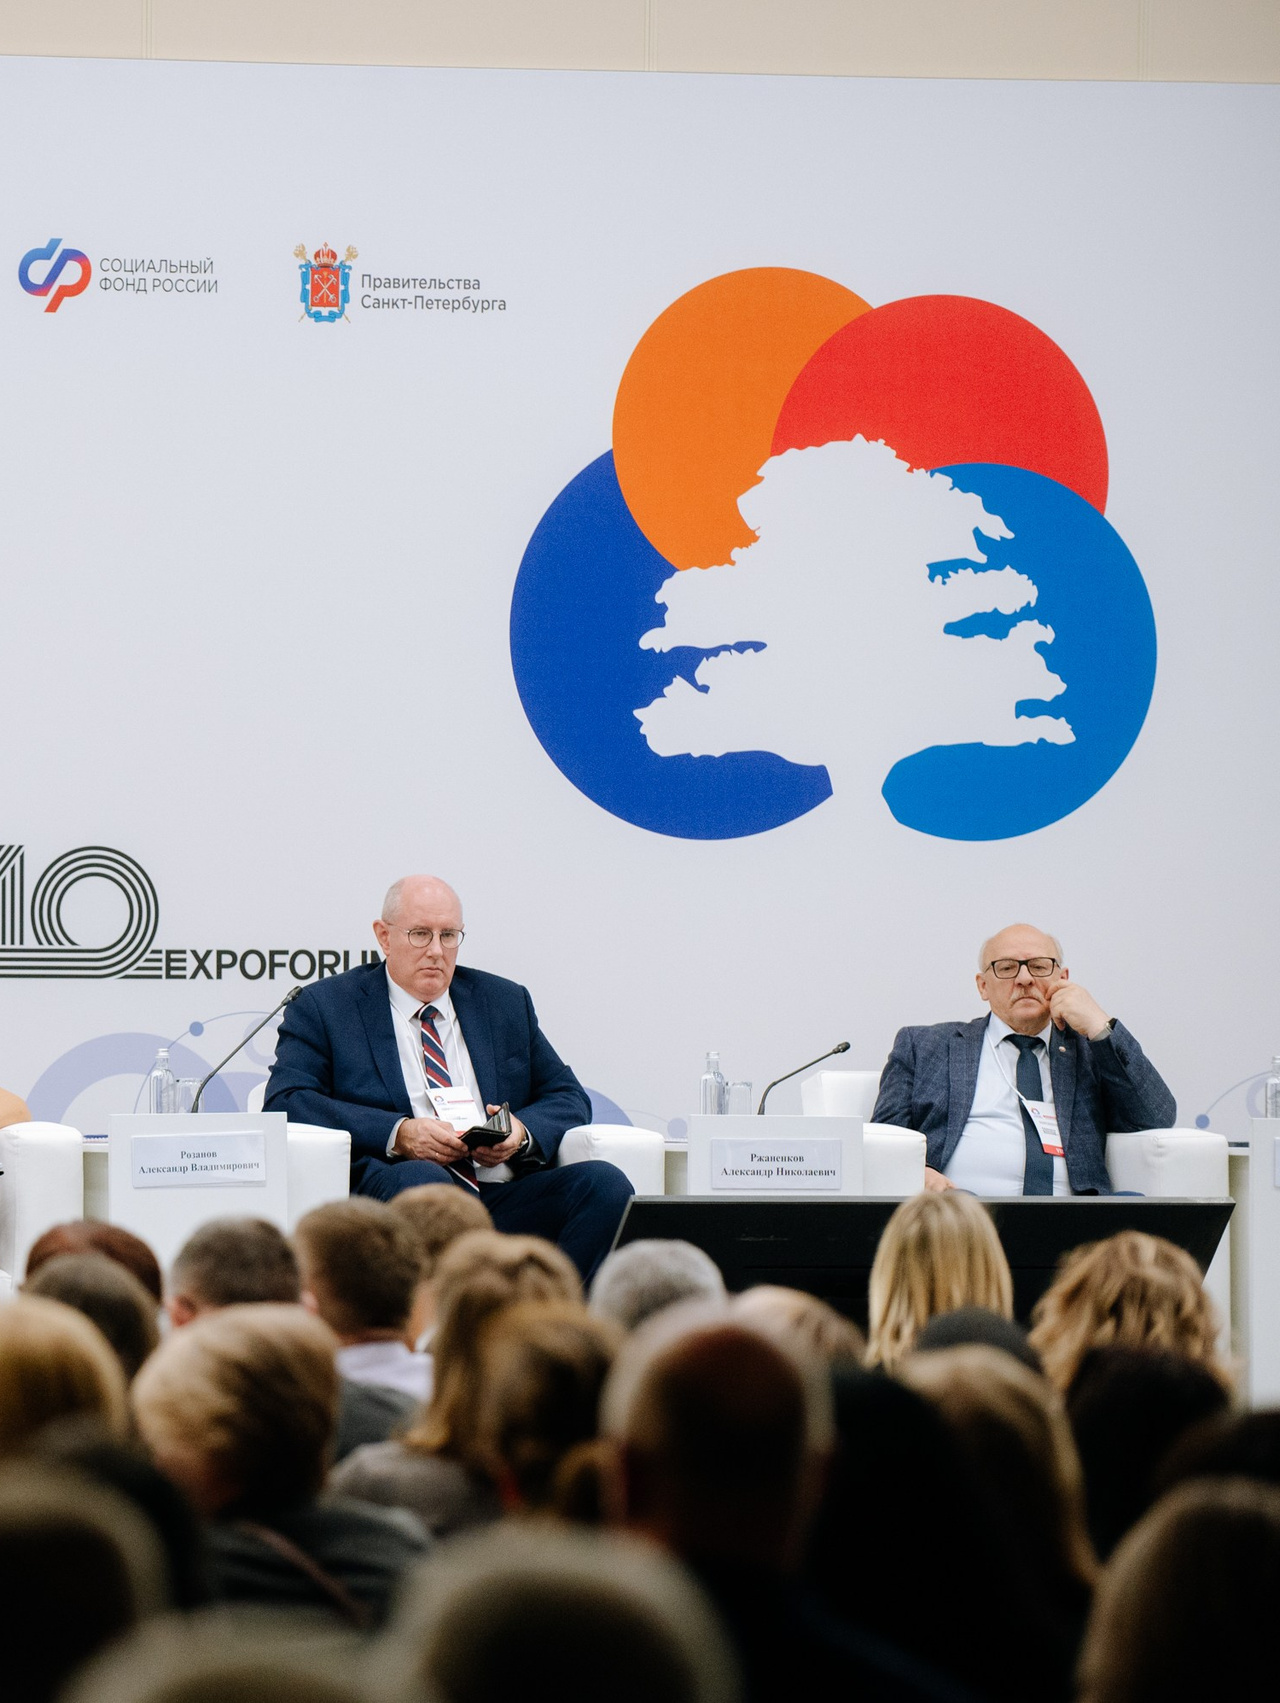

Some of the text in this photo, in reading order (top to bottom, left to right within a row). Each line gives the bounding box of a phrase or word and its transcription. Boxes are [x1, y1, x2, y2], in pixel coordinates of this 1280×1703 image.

[99, 257, 214, 275] СОЦИАЛЬНЫЙ
[99, 277, 218, 295] ФОНД РОССИИ
[361, 273, 481, 291] Правительства
[361, 294, 507, 314] Санкт-Петербурга
[180, 1150, 218, 1160] Розанов
[750, 1152, 805, 1164] Ржаненков
[138, 1160, 260, 1175] Александр Владимирович
[721, 1166, 837, 1178] Александр Николаевич
